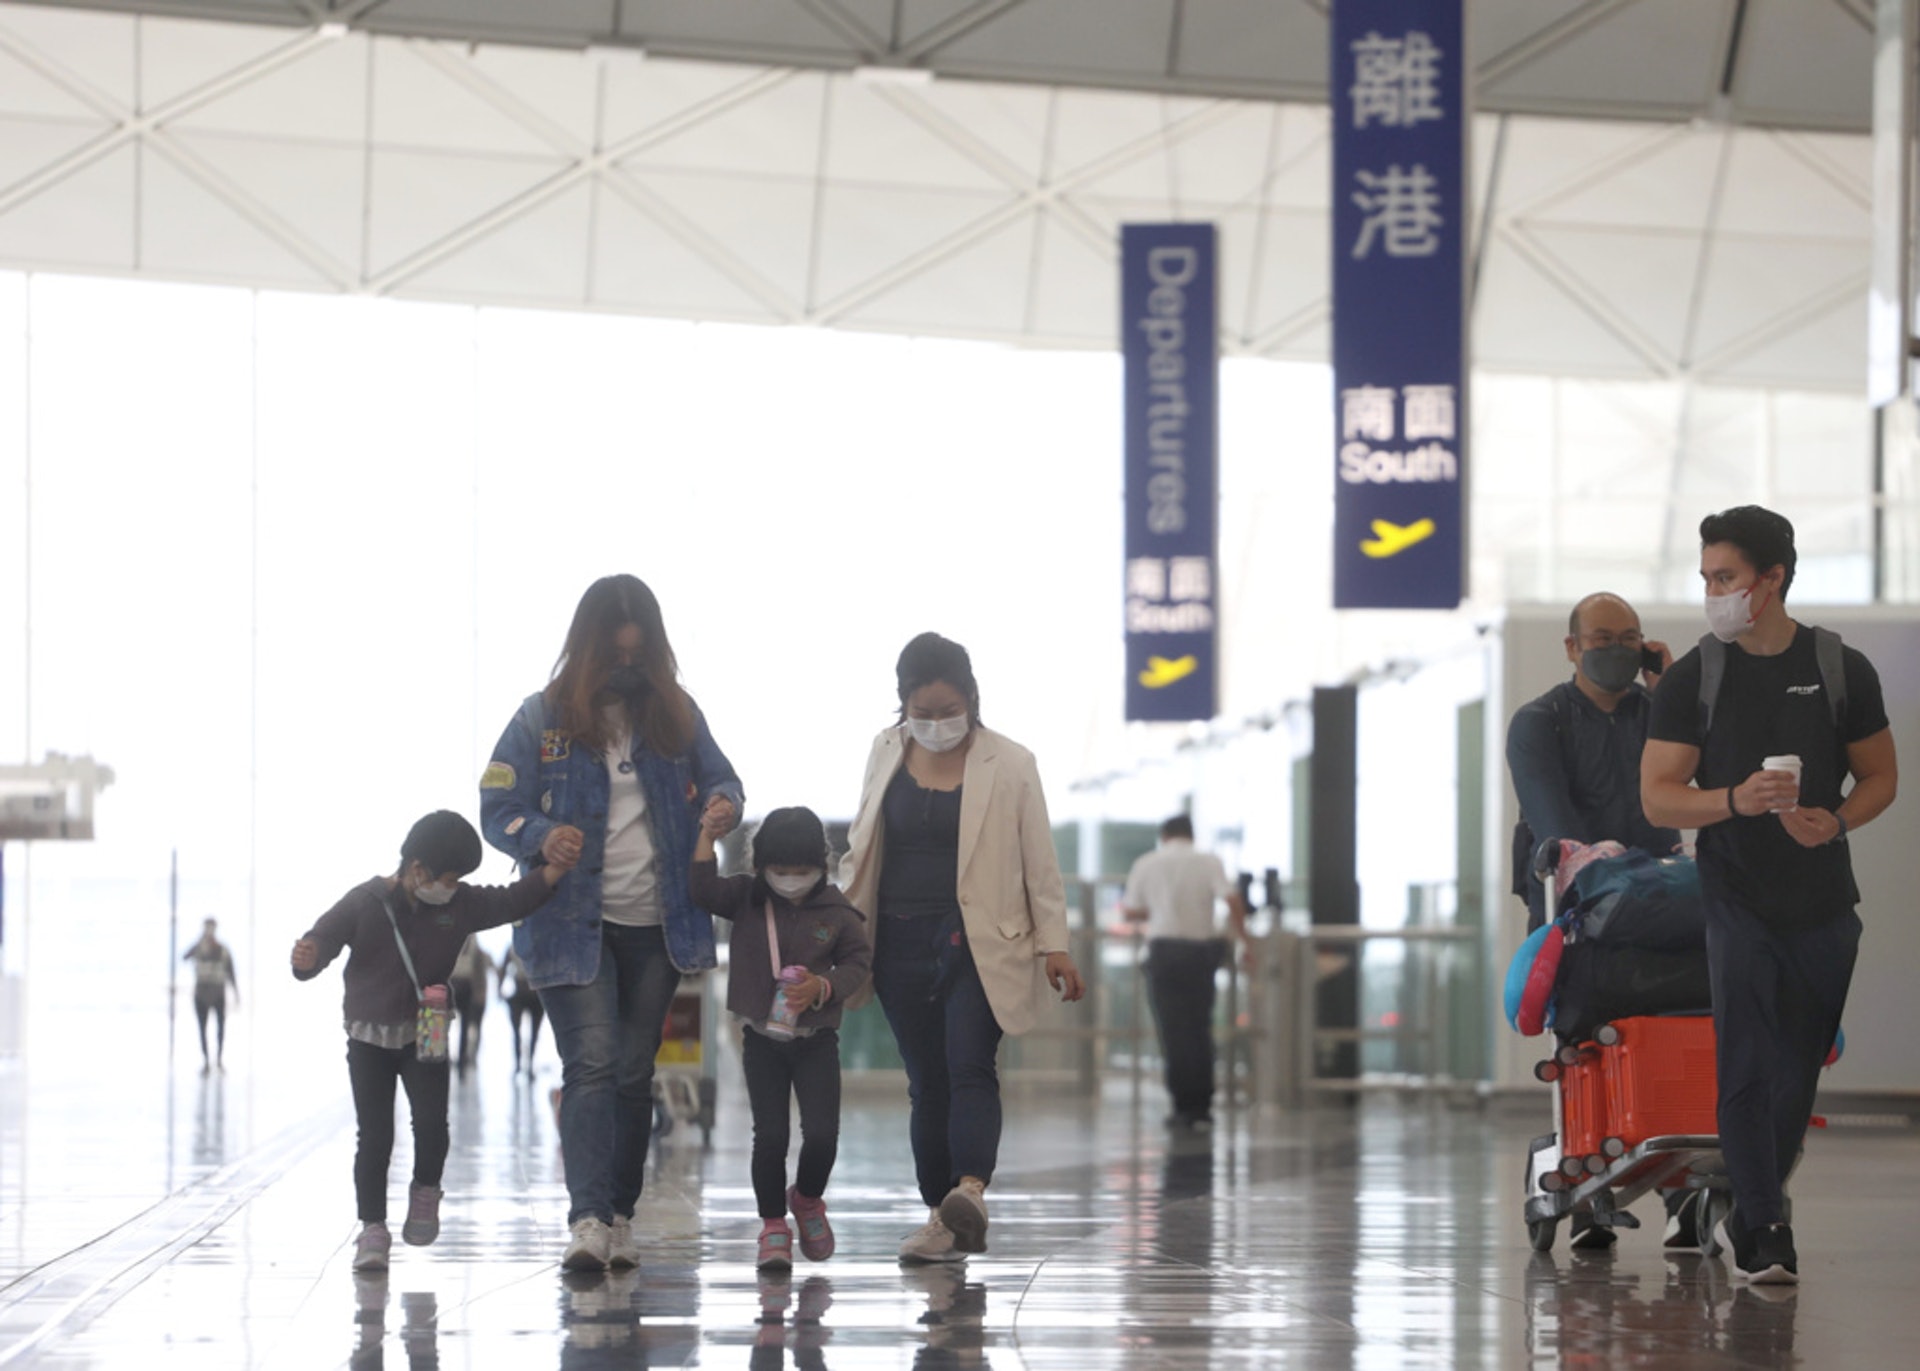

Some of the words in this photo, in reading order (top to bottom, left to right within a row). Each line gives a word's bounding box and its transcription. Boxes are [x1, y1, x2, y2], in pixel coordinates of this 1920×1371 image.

[1349, 31, 1443, 259] 離港
[1139, 246, 1197, 533] Departures
[1339, 442, 1457, 483] South
